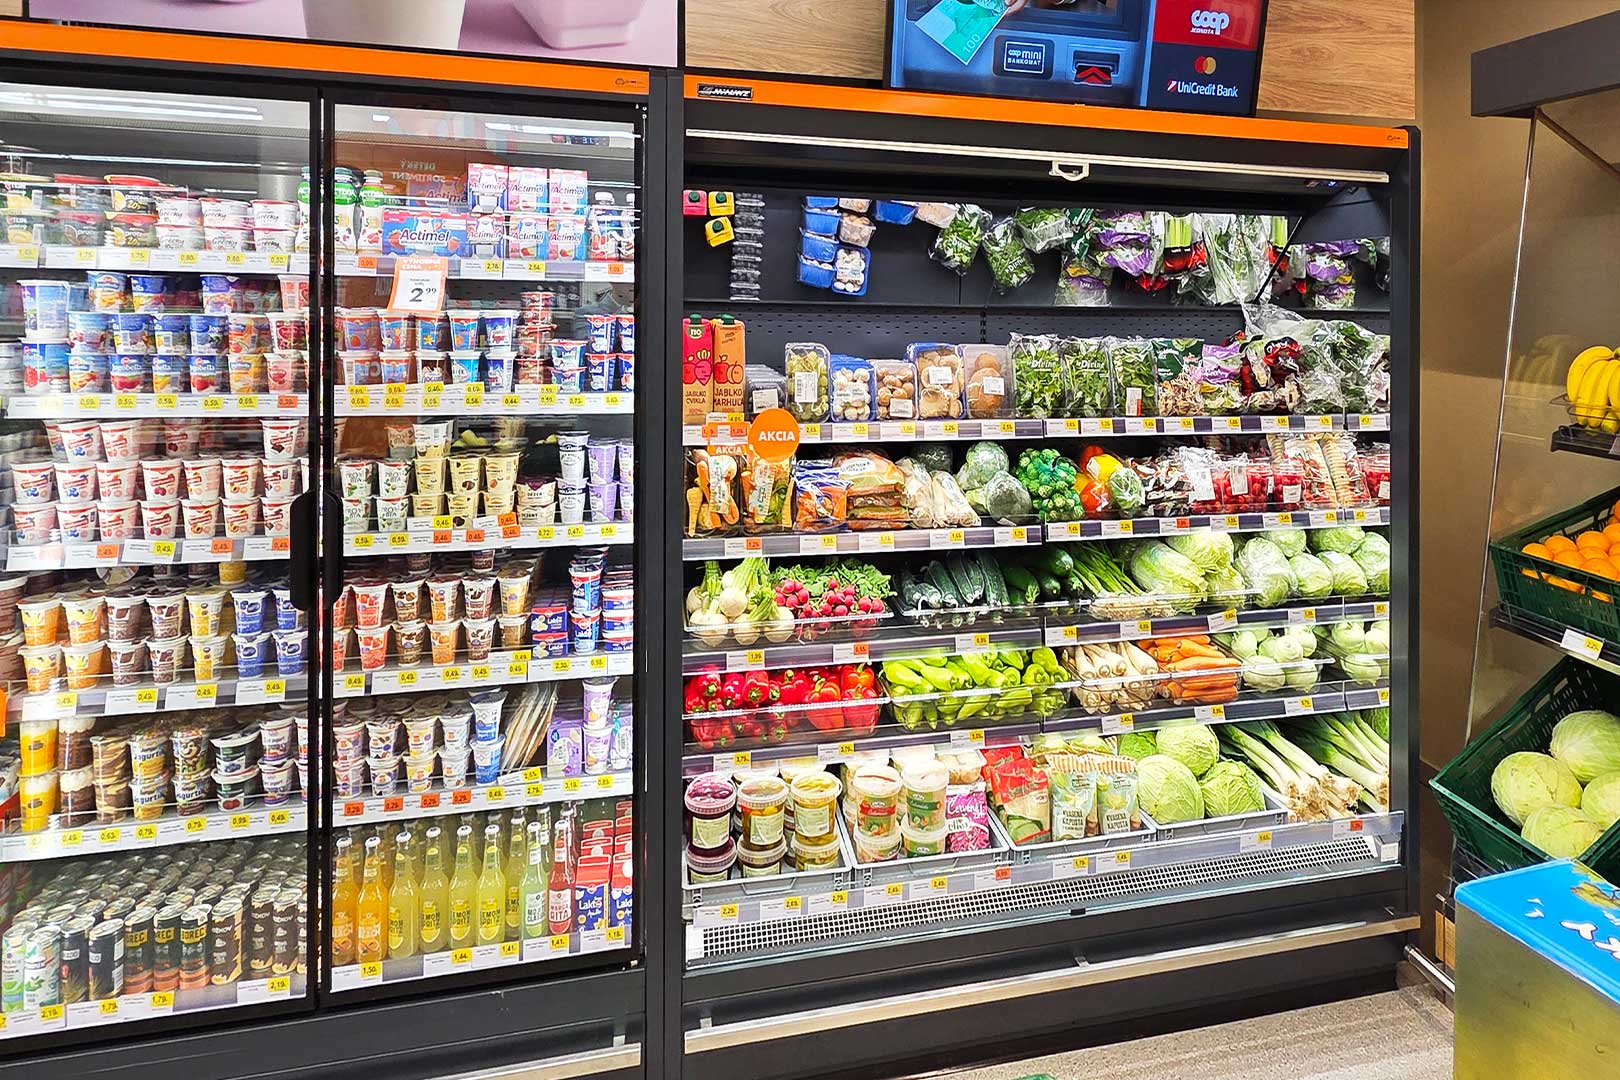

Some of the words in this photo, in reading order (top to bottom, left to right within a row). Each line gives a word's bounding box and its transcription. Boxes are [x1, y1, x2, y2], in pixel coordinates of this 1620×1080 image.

[1191, 10, 1229, 35] coop
[1022, 50, 1041, 60] mini
[1007, 58, 1041, 66] BANKOMAT
[1177, 81, 1215, 96] UniCredit
[1216, 84, 1239, 97] Bank
[399, 229, 450, 243] Actimel
[714, 387, 743, 398] JABLKO
[758, 430, 796, 442] AKCIA
[715, 446, 742, 454] AKCIA
